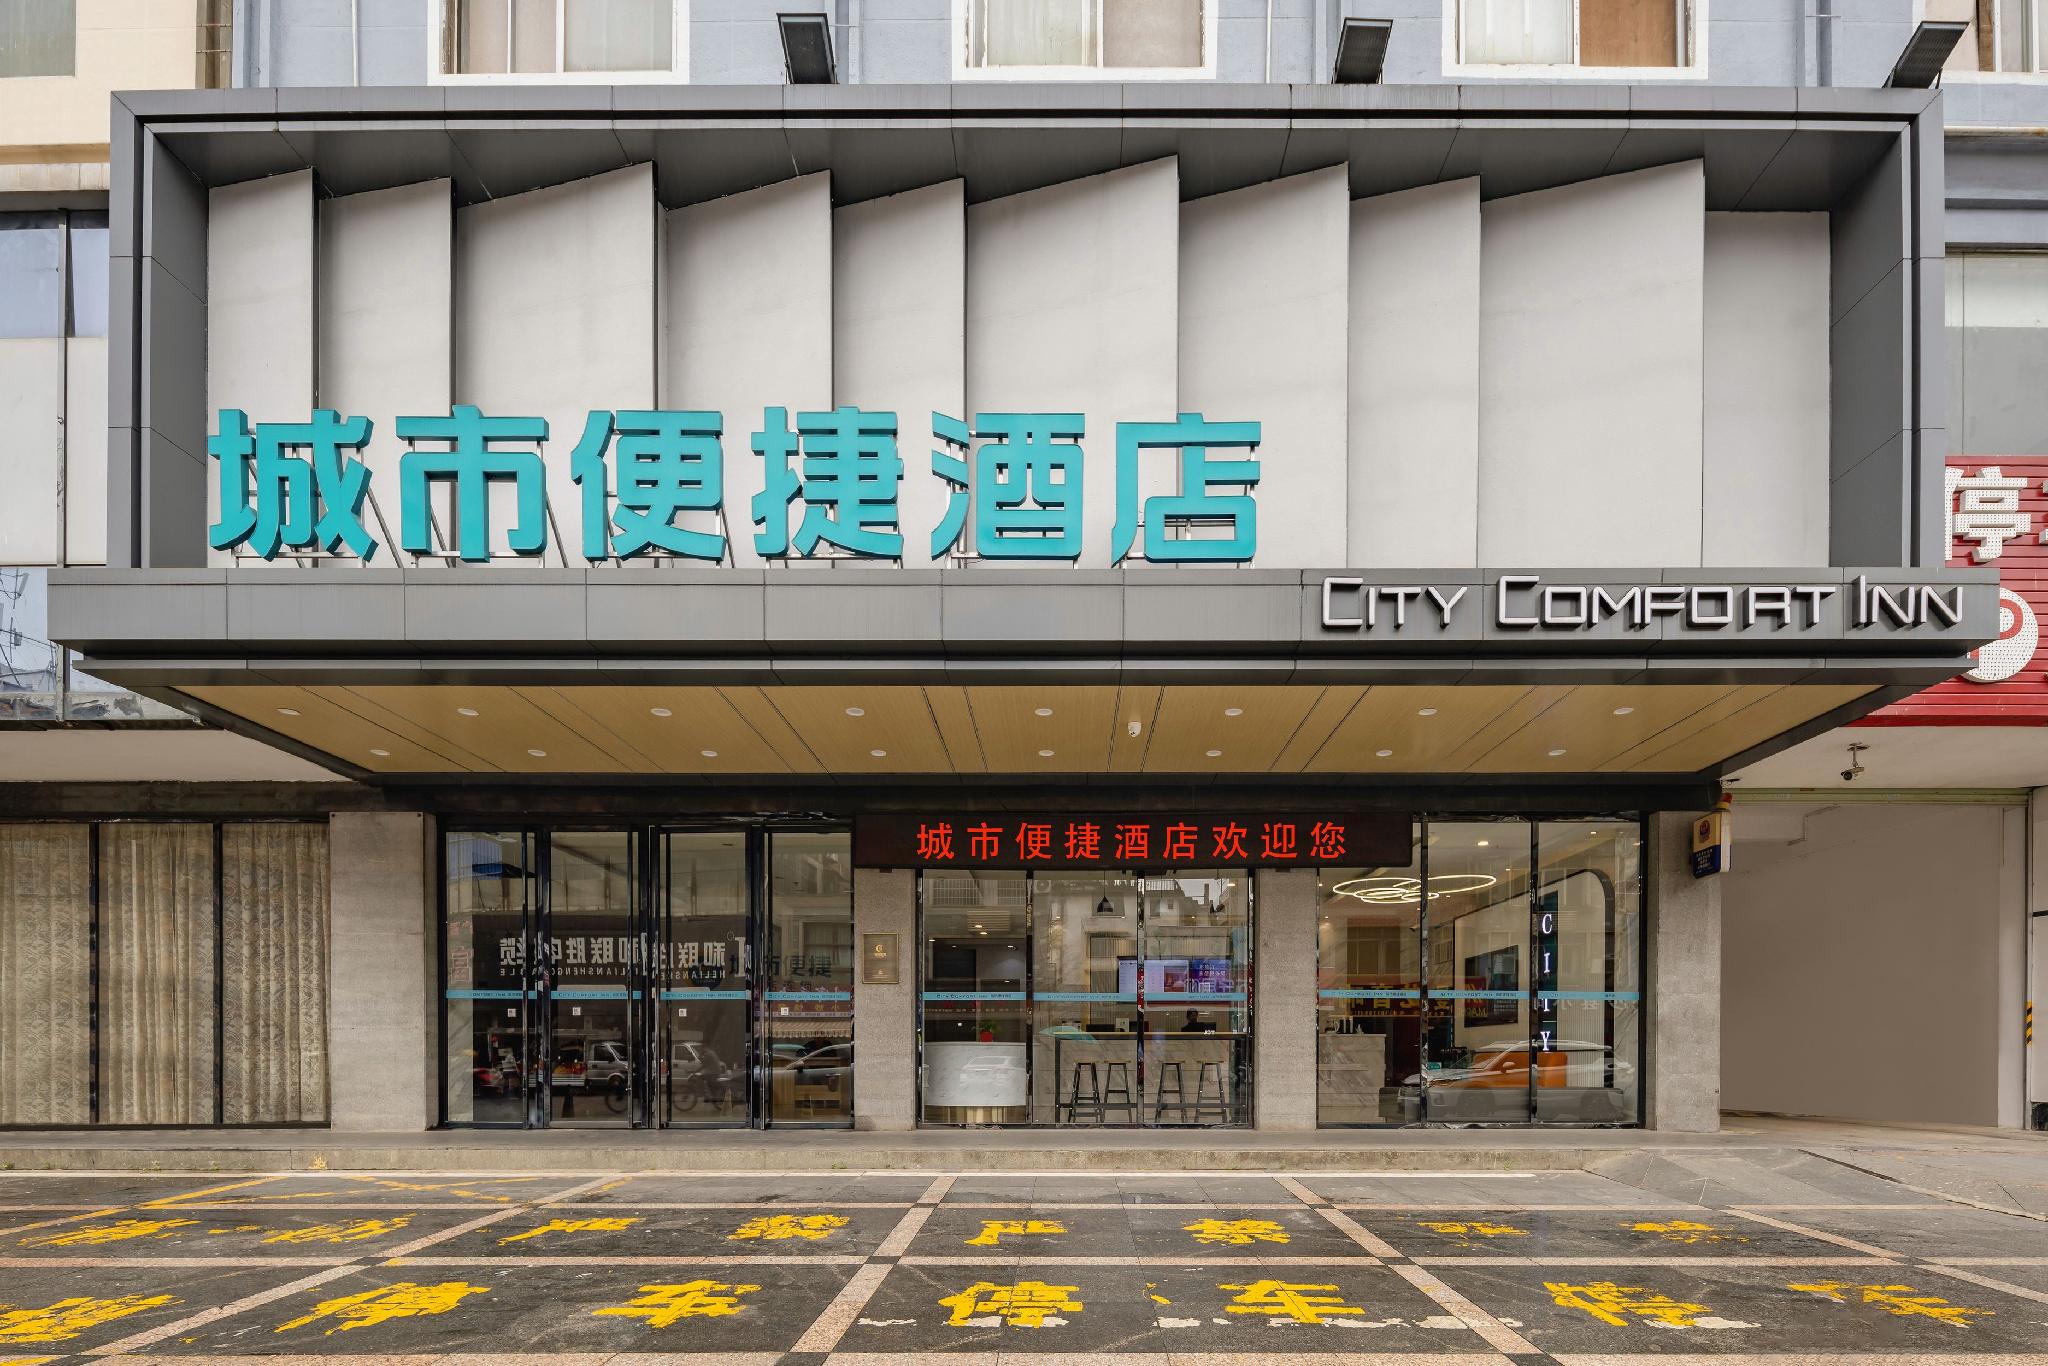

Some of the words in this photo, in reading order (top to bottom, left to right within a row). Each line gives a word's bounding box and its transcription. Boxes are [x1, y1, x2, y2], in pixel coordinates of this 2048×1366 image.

[207, 405, 1261, 566] 城市便捷酒店
[1945, 466, 2048, 560] 停
[1322, 577, 1469, 627] CITY
[1498, 575, 1838, 629] COMFORT
[1858, 573, 1964, 625] INN
[917, 822, 1346, 860] 城市便捷酒店欢迎您
